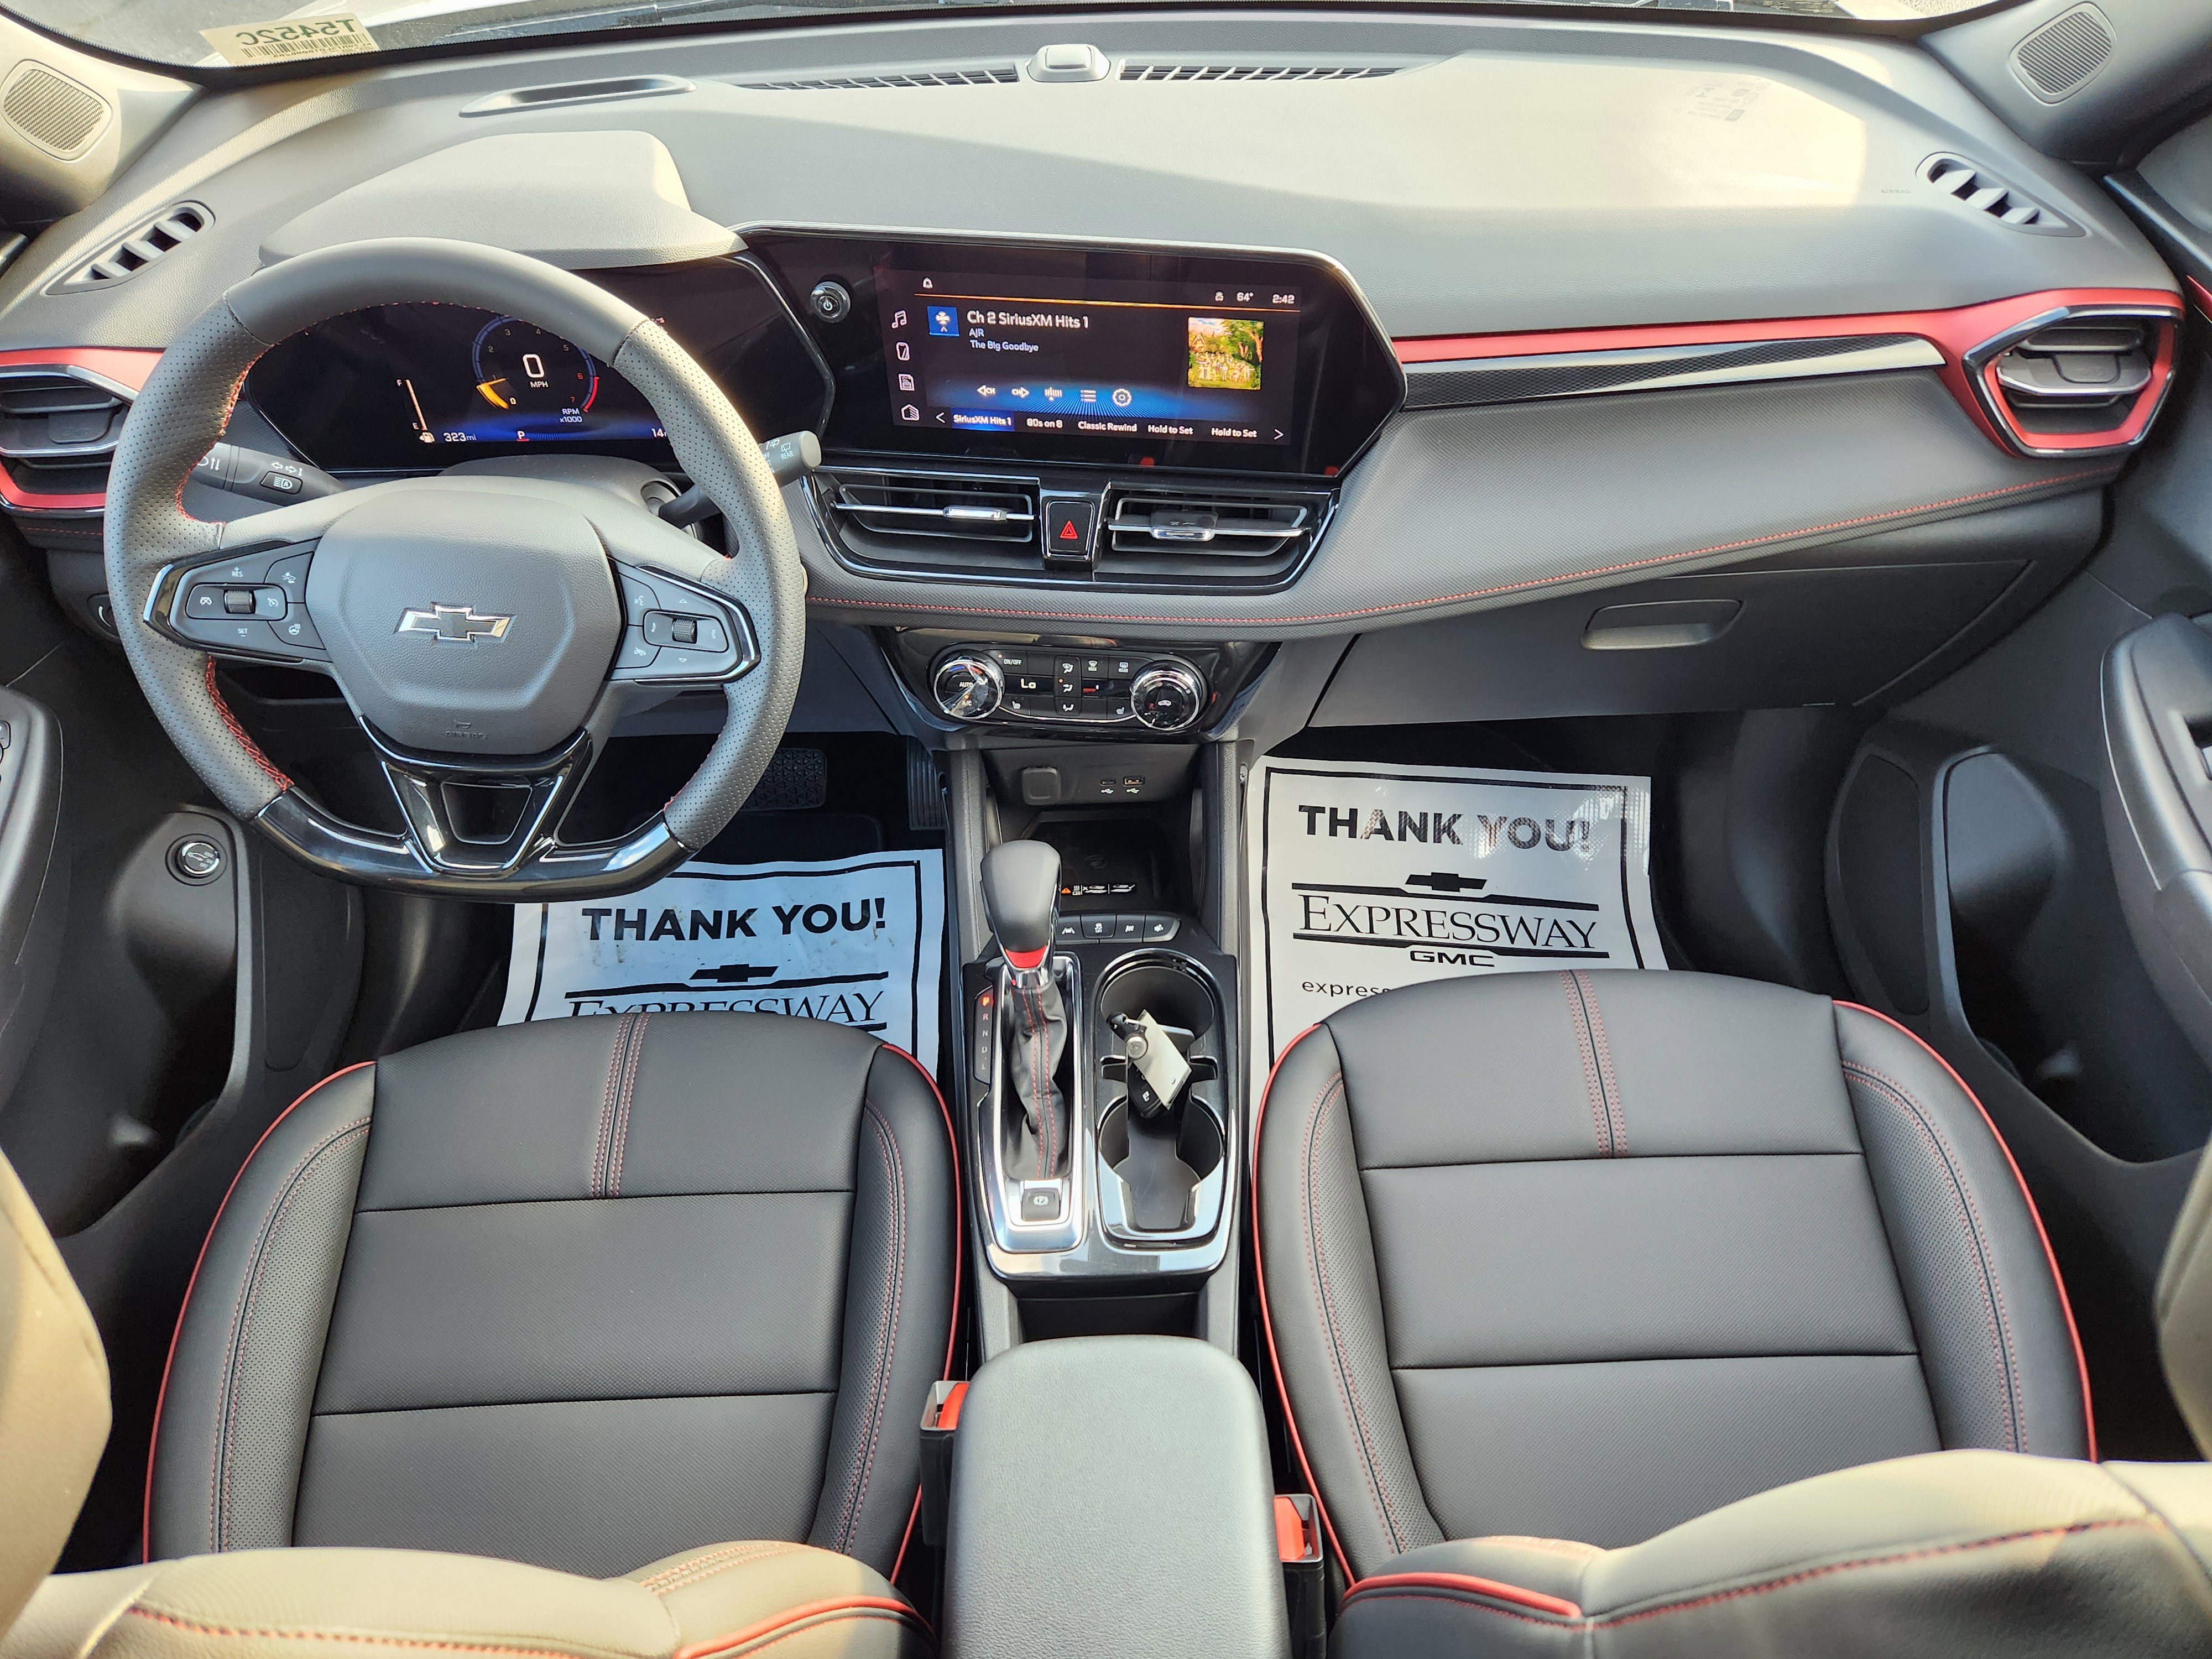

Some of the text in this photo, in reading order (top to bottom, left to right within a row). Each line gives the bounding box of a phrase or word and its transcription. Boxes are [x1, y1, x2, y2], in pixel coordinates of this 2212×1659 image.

[1272, 295, 1295, 304] 2:42
[967, 310, 1088, 329] Ch 2 SiriusXM Hits 1
[969, 327, 984, 338] AJR
[970, 340, 1039, 353] The Big Goodbye
[523, 354, 545, 378] 0
[953, 415, 988, 424] SiriusXM
[1056, 419, 1063, 427] 8
[1078, 421, 1137, 432] Classic Rewind
[1148, 424, 1168, 434] Hold
[1179, 426, 1193, 435] Set
[1212, 428, 1257, 438] Hold to Set
[780, 451, 794, 460] REAR
[1299, 805, 1590, 852] THANK YOU!
[582, 898, 886, 941] THANK YOU!
[1298, 894, 1597, 949] EXPRESSWAY
[1410, 950, 1495, 967] GMC
[983, 997, 989, 1006] P
